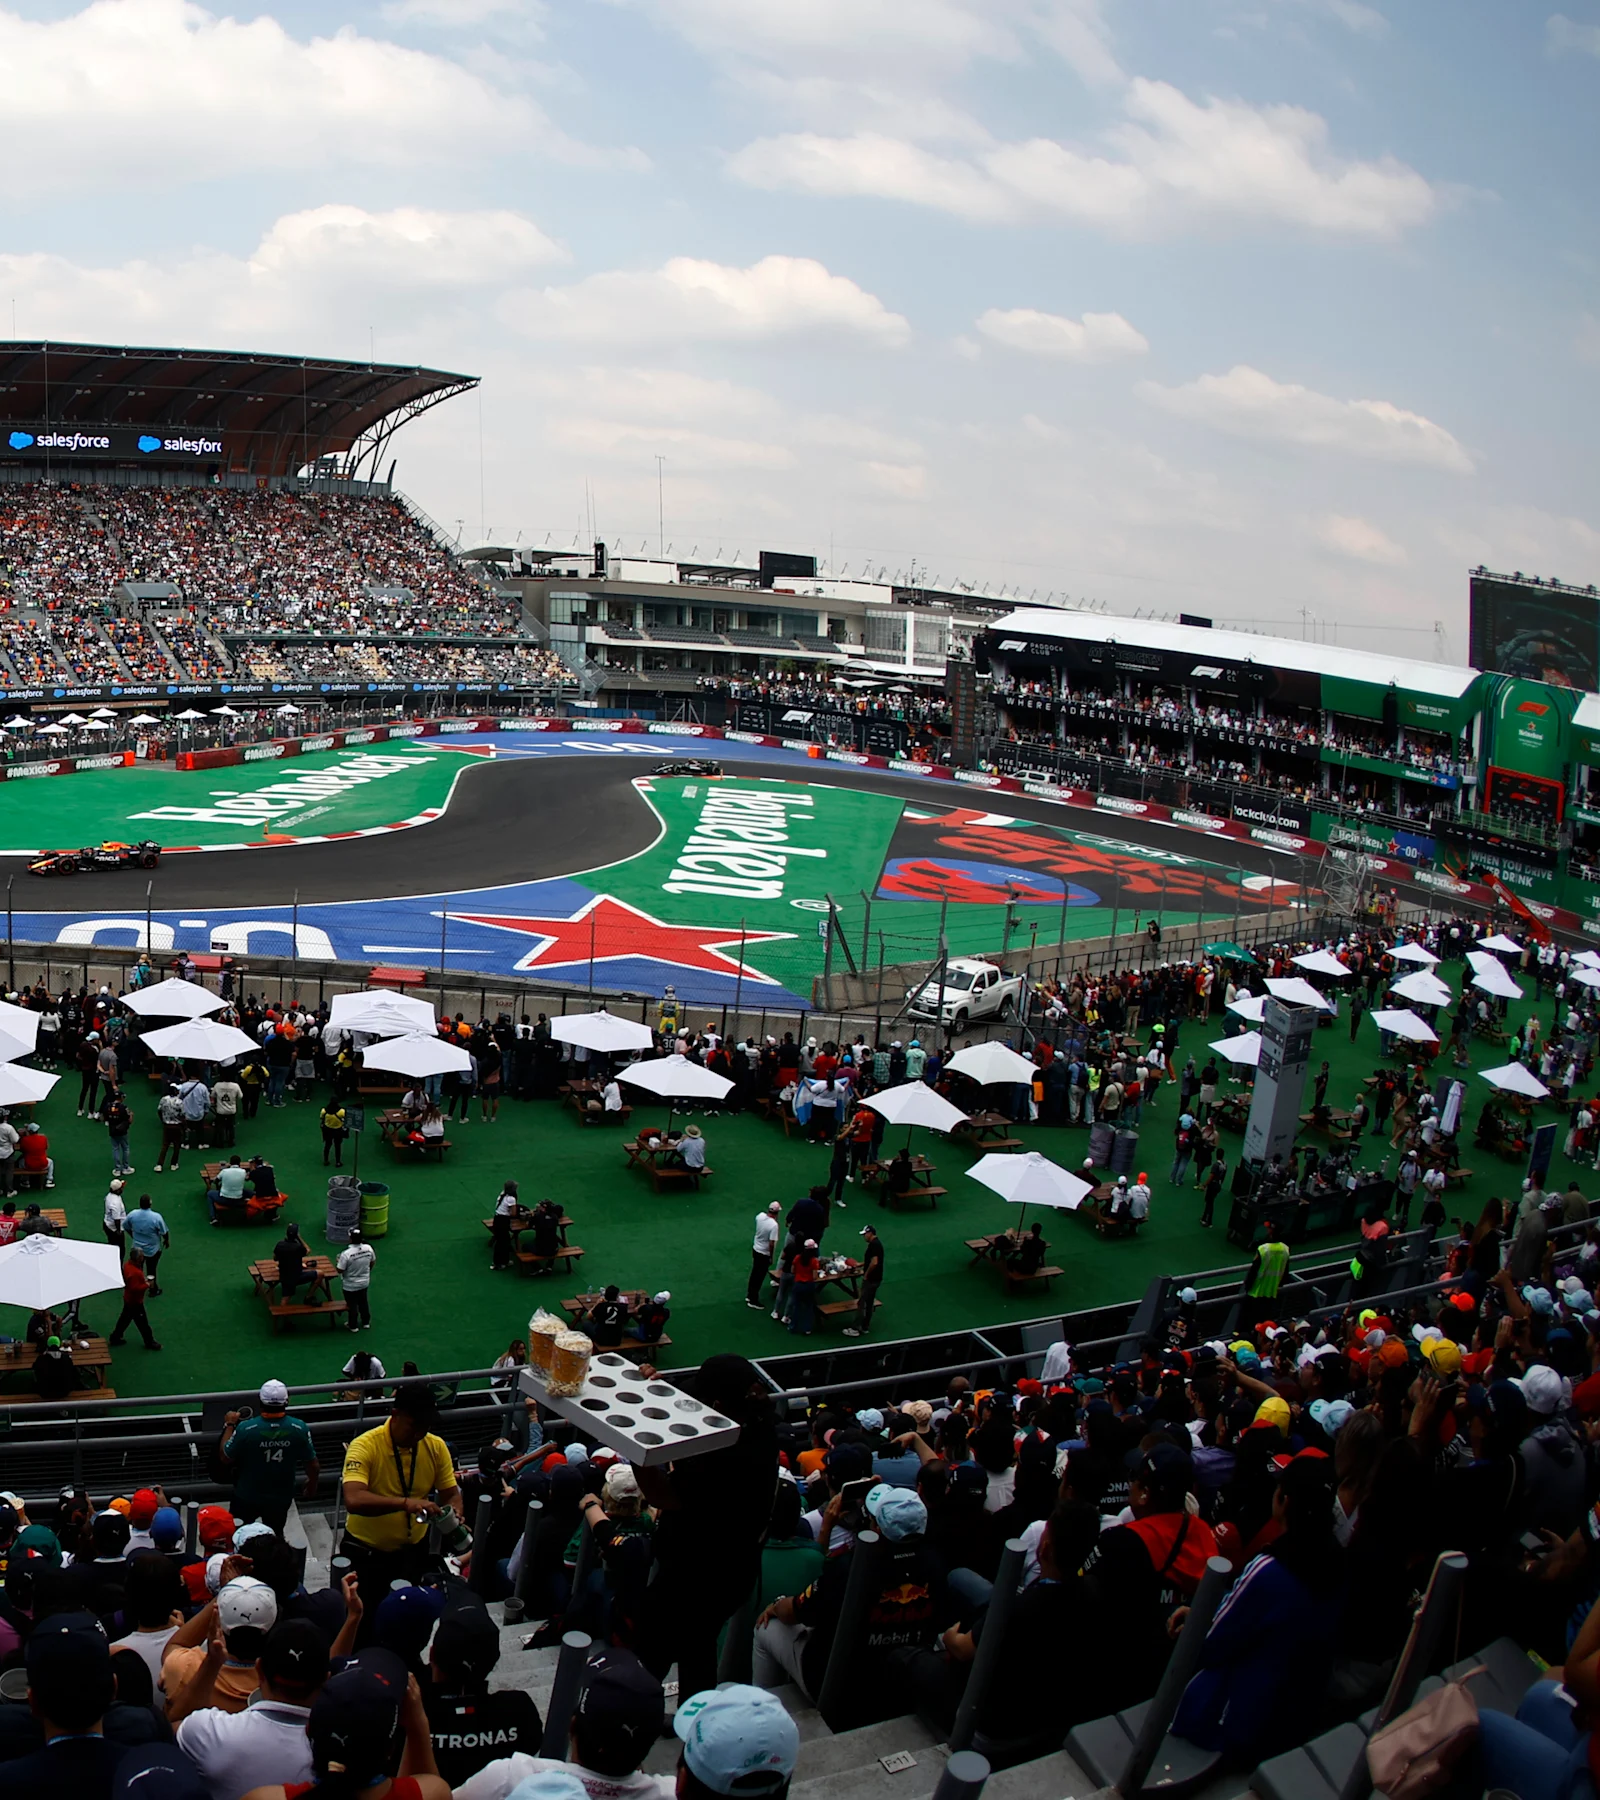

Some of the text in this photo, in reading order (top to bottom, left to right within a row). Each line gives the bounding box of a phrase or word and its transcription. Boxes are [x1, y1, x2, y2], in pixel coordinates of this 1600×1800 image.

[37, 432, 109, 451] salesforce
[1029, 642, 1063, 653] PADDOCK
[1030, 648, 1050, 656] CLUB
[7, 688, 44, 700] salesforce
[66, 687, 101, 698] salesforce
[123, 686, 157, 697] salesforce
[178, 684, 212, 695] salesforce
[232, 684, 263, 694] salesforce
[283, 684, 312, 694] salesforce
[331, 683, 360, 693] salesforce
[377, 683, 406, 692] salesforce
[816, 713, 852, 723] PADDOCK
[816, 720, 836, 728] CLUB
[389, 726, 424, 738] #MexicoGP
[440, 721, 479, 732] #MexicoGP
[500, 720, 550, 731] #MexicoGP
[572, 721, 623, 732] #MexicoGP
[649, 724, 704, 736] #MexicoGP
[1005, 698, 1297, 754] WHERE ADRENALINE MEETS ELEGANCE
[345, 731, 375, 745] #MexicoGP
[725, 731, 764, 743] #MexicoGP
[301, 737, 334, 752] #MexicoGP
[244, 745, 285, 761] #MexicoGP
[826, 751, 869, 764] #MexicoGP
[76, 755, 124, 770] #MexicoGP
[888, 760, 933, 774] #MexicoGP
[999, 757, 1014, 766] SEE
[1018, 761, 1034, 769] THE
[1037, 765, 1077, 777] FORMULA
[7, 763, 60, 778] #MexicoGP
[954, 771, 1001, 786] #MexicoGP
[126, 755, 437, 826] Heineken
[1024, 782, 1073, 799] #MexicoGP
[1096, 796, 1148, 813] #MexicoGP
[1172, 811, 1225, 829] #MexicoGP
[1234, 805, 1300, 829] ockclub.com
[662, 787, 827, 899] Heineken
[1251, 829, 1305, 848] #MexicoGP
[1470, 848, 1553, 881] WHEN YOU DRIVE
[259, 1440, 291, 1448] ALONSO
[263, 1449, 284, 1463] 14
[868, 1632, 910, 1647] Mobil
[683, 1702, 707, 1716] 11
